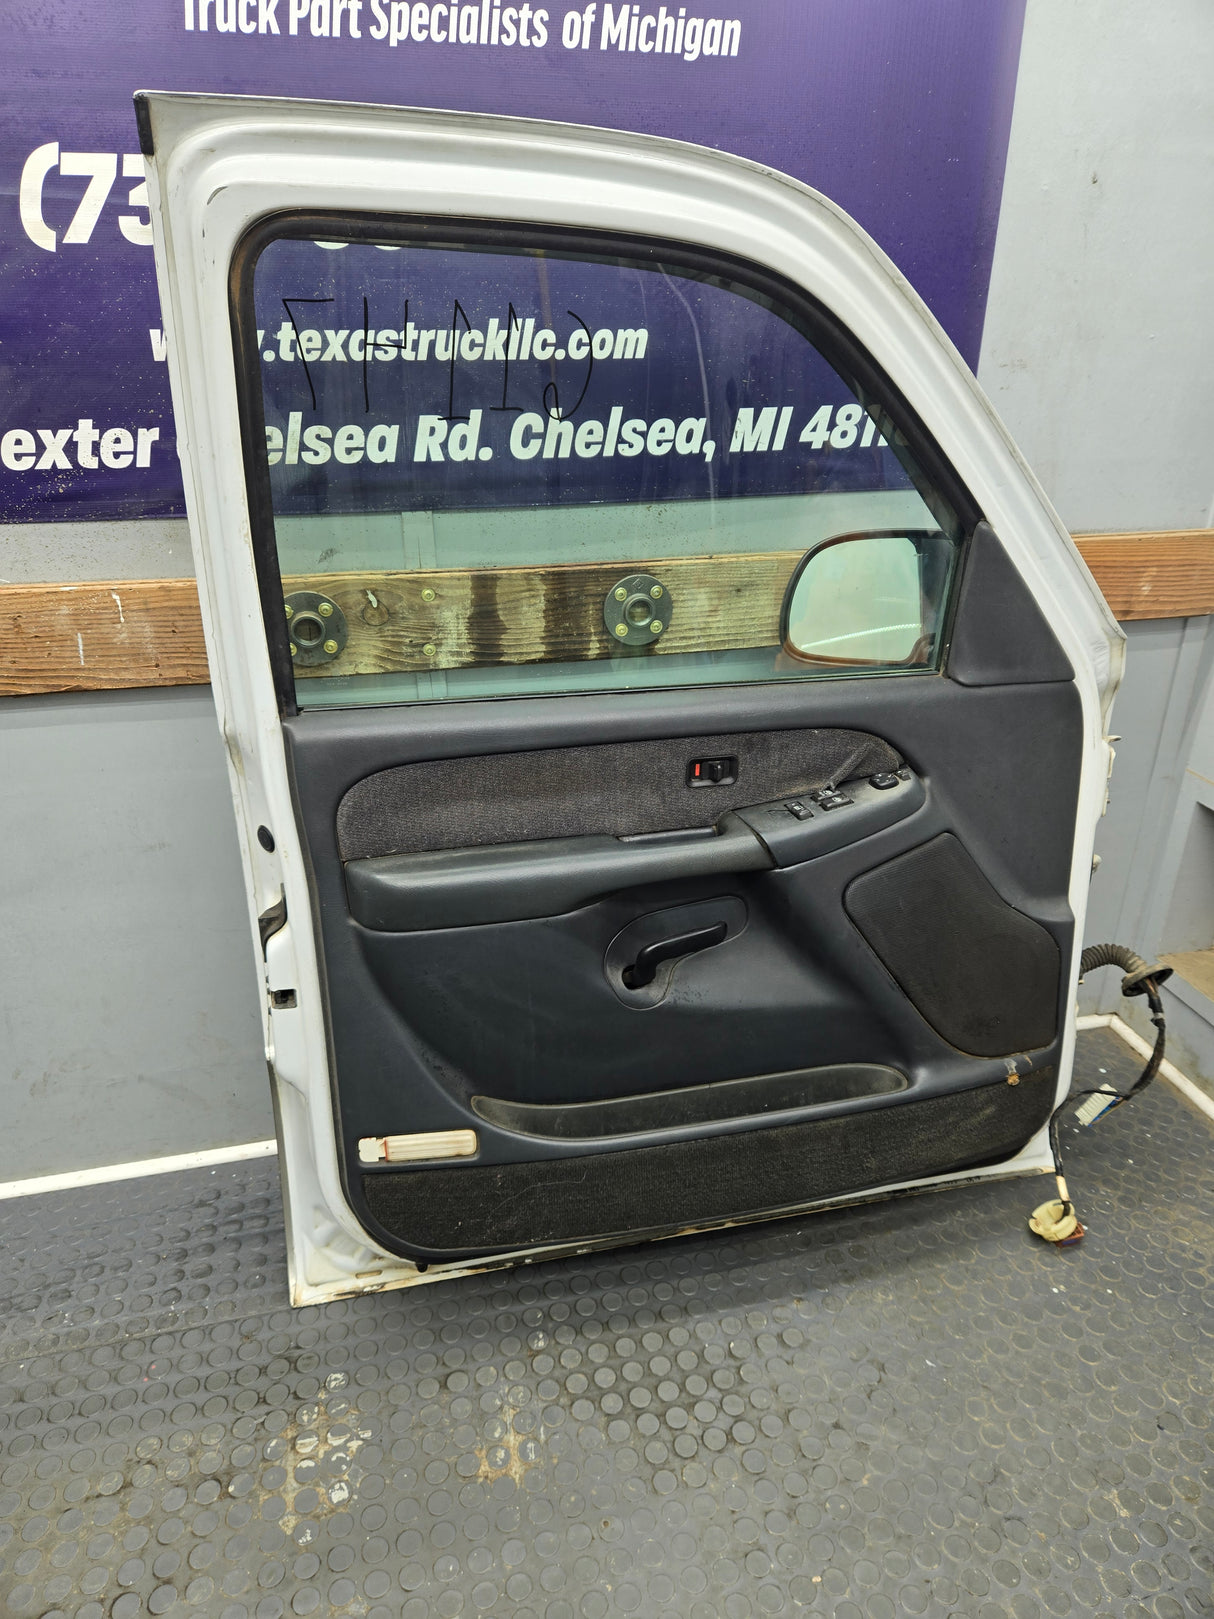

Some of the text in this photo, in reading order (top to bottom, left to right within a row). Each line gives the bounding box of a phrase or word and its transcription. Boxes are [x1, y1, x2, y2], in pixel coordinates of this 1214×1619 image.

[289, 0, 363, 39] Part
[369, 0, 549, 49] Specialists
[562, 2, 597, 50] of
[600, 3, 742, 62] Michigan
[19, 141, 154, 253] (73
[0, 403, 888, 471] exter elsea Rd. Chelsea, MI 481
